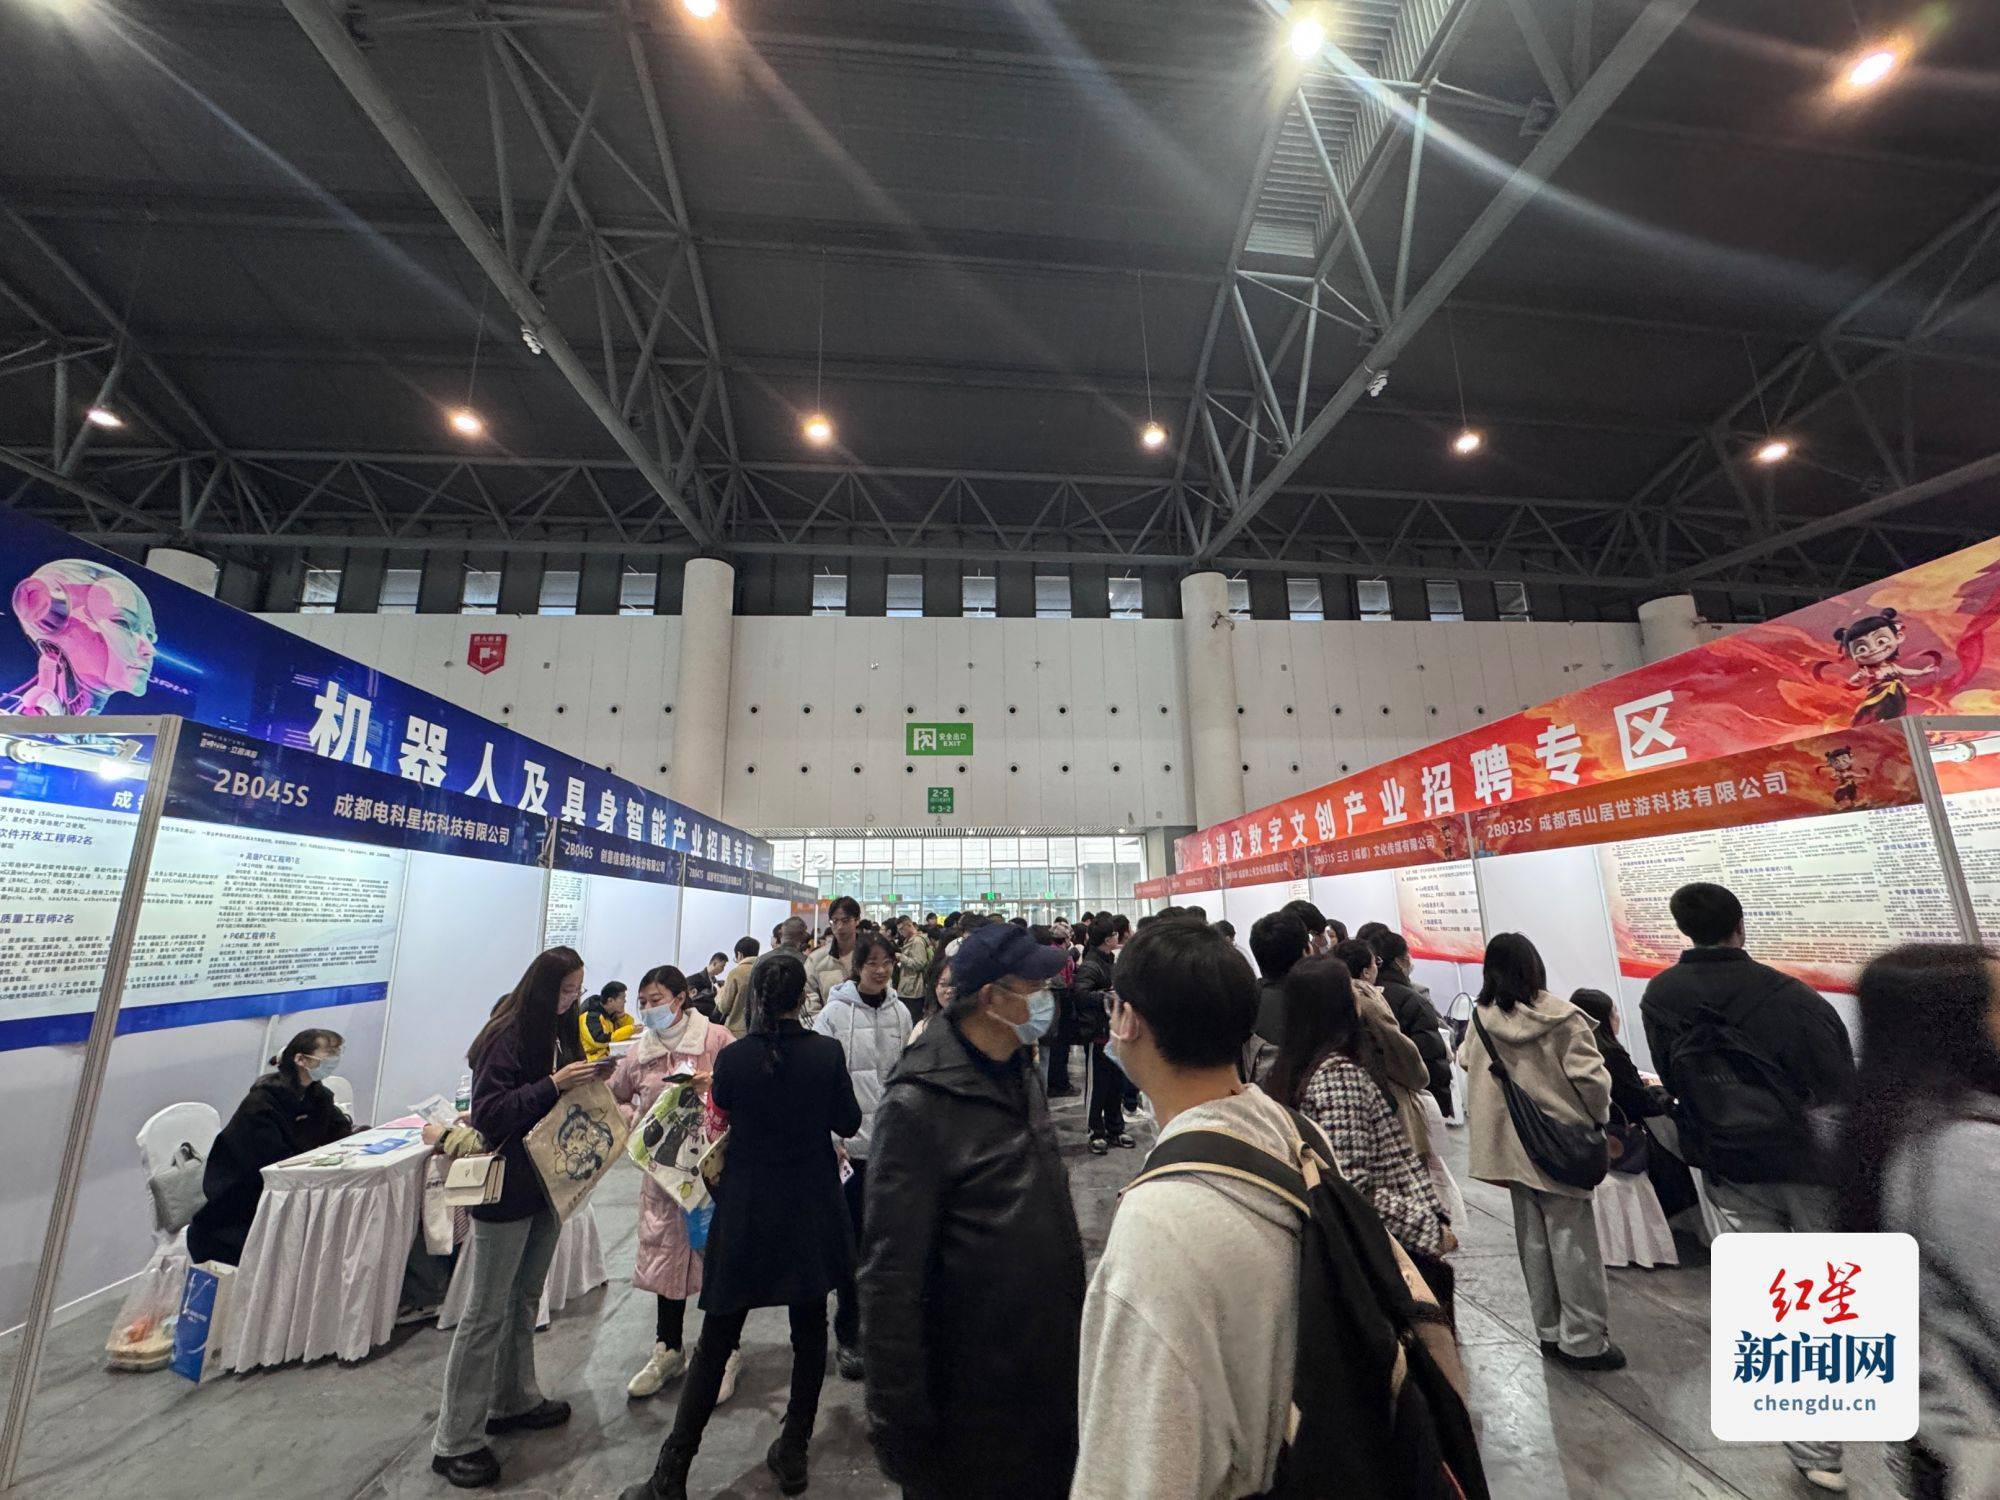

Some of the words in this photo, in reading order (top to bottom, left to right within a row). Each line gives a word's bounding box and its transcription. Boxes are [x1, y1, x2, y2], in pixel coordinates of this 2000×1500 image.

[213, 769, 309, 807] 2B045S
[333, 793, 510, 846] 成都电科星拓科技有限公司
[308, 681, 754, 870] 机器人及具身智能产业招聘专区
[1202, 690, 1687, 865] 动漫及数字文创产业招聘专区
[1487, 818, 1533, 838] 2B032S
[1539, 771, 1788, 831] 成都西山居世游科技有限公司
[564, 842, 594, 859] 2B046S
